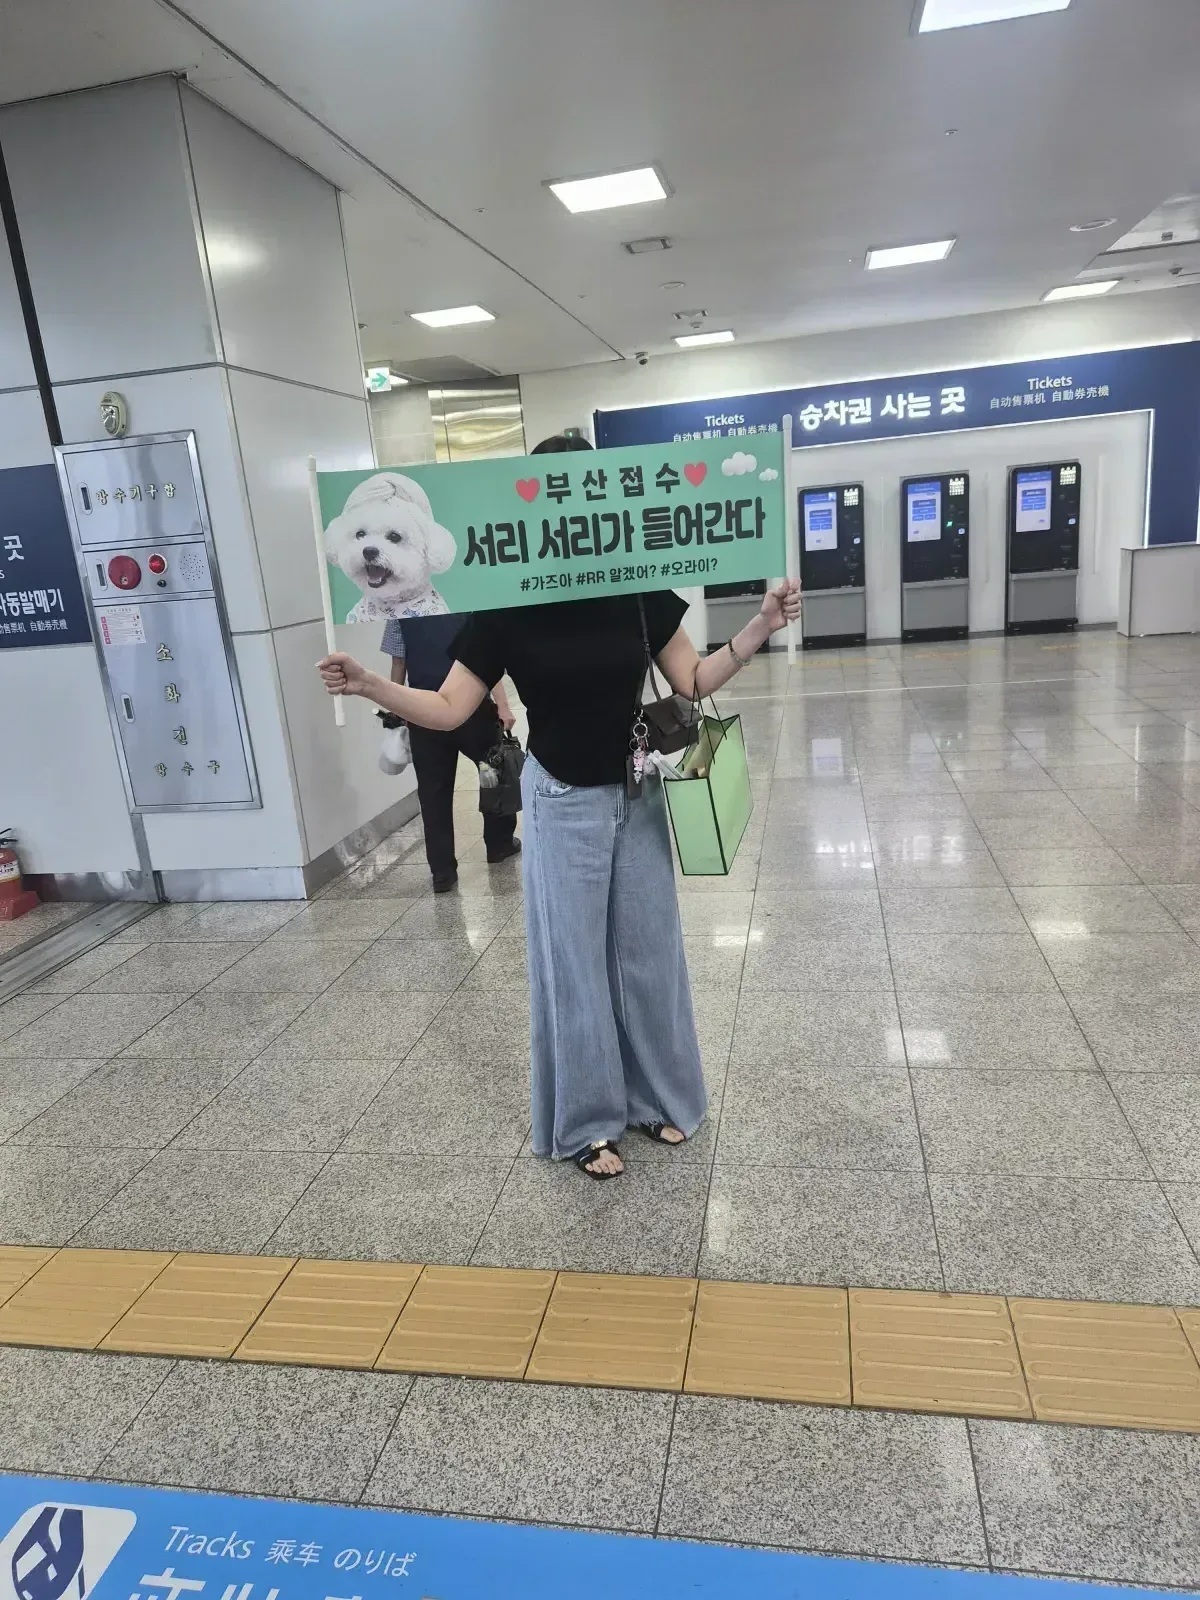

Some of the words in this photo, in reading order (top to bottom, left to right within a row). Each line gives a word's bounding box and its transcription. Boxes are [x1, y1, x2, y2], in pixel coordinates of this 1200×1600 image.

[990, 393, 1046, 410] 自动售票机
[1052, 385, 1110, 403] 自動券売機
[1027, 375, 1073, 391] Tickets
[704, 413, 745, 428] Tickets
[799, 396, 873, 430] 승차권
[879, 391, 932, 420] 사는
[940, 385, 967, 416] 곳
[463, 519, 530, 567] 서리
[537, 508, 635, 560] 서리가
[641, 496, 767, 552] 들어간다
[3, 535, 25, 561] 곳
[520, 572, 573, 592] #가즈아
[575, 570, 606, 586] #RR
[609, 564, 657, 583] 알겠어?
[660, 557, 718, 577] #오라이?
[164, 1525, 256, 1560] Tracks
[333, 1547, 418, 1578] のりば
